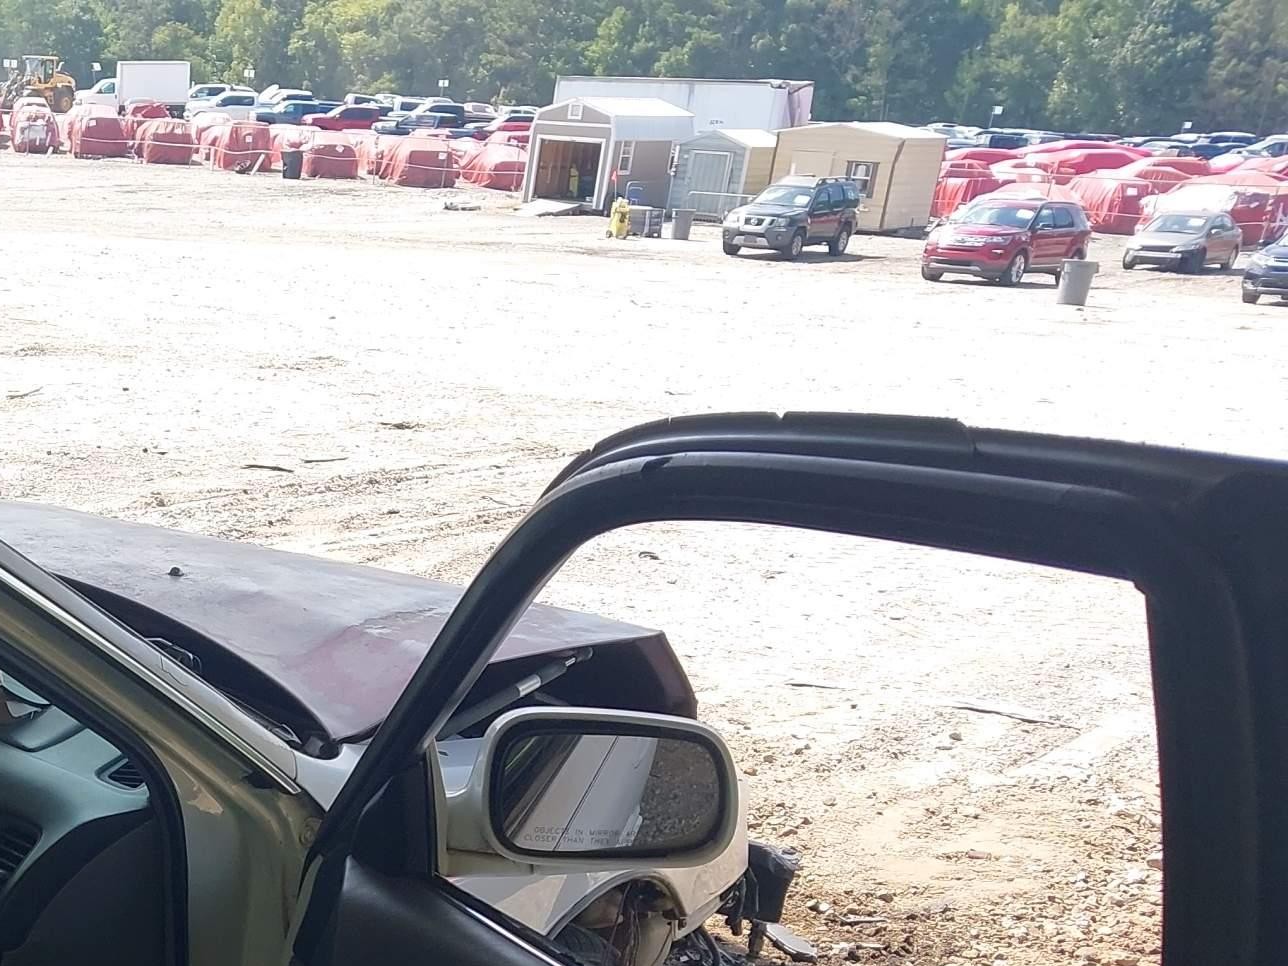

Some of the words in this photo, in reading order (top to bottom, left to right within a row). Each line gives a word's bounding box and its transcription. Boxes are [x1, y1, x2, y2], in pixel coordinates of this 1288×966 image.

[534, 826, 570, 835] OBJECT
[589, 829, 619, 837] MIRROR
[523, 834, 556, 842] CLOSER
[562, 836, 584, 844] THAN
